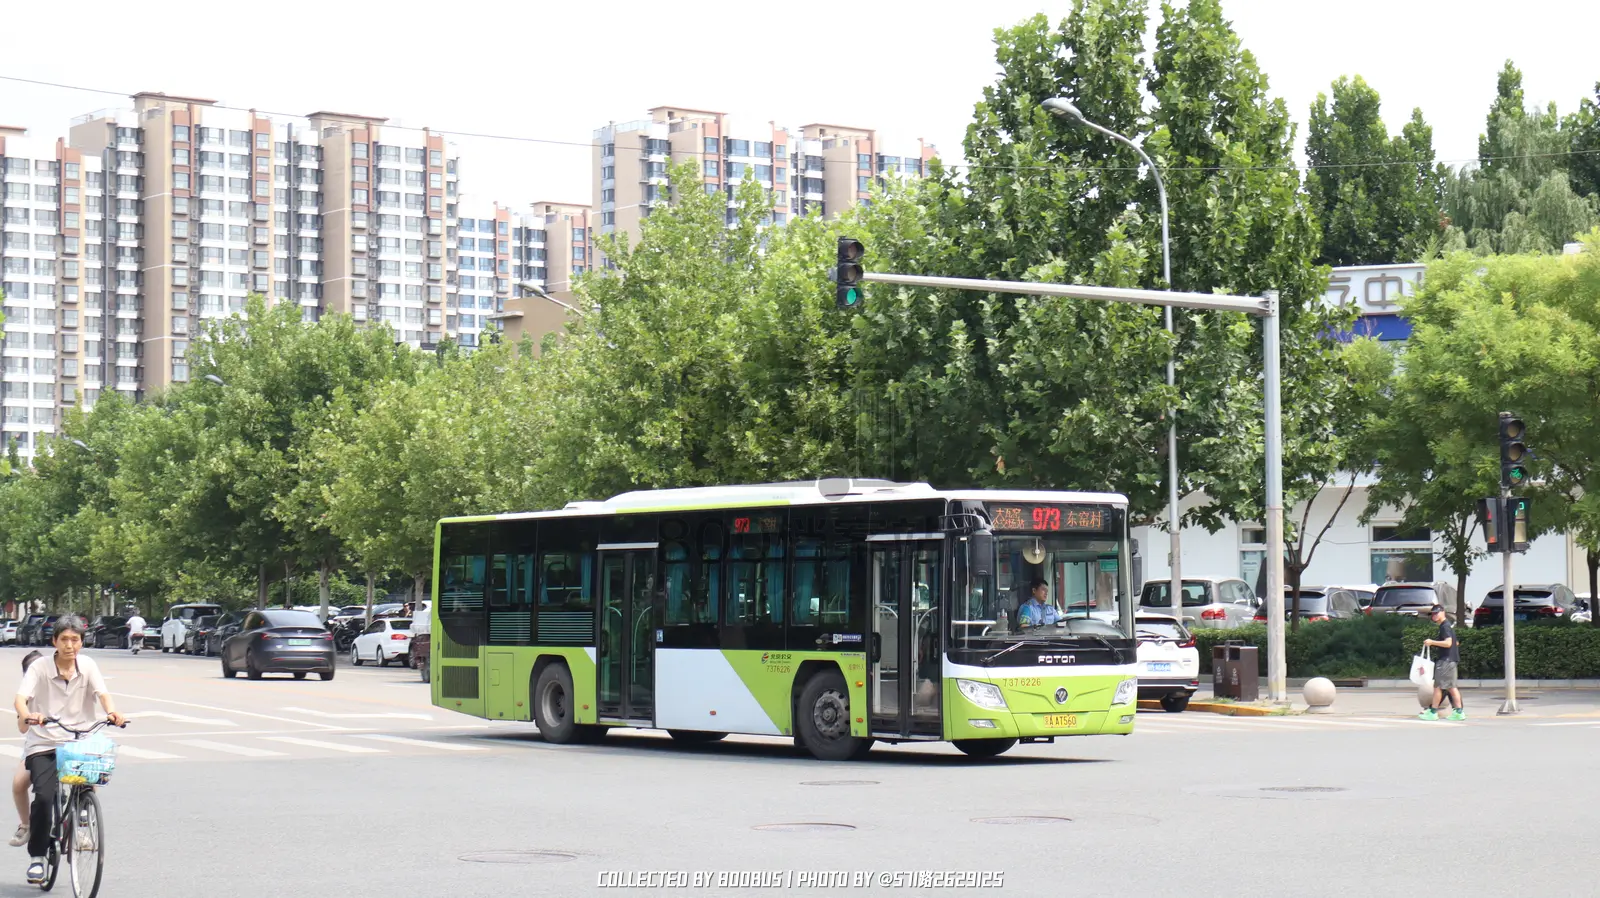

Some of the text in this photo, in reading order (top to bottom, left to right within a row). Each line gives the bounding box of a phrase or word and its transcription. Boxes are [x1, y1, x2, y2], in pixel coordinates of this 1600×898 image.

[1032, 507, 1102, 531] 973 东窑村
[734, 517, 751, 533] 973
[1037, 654, 1076, 664] FOTON
[766, 664, 791, 673] 7376226
[1002, 677, 1042, 687] 7376226
